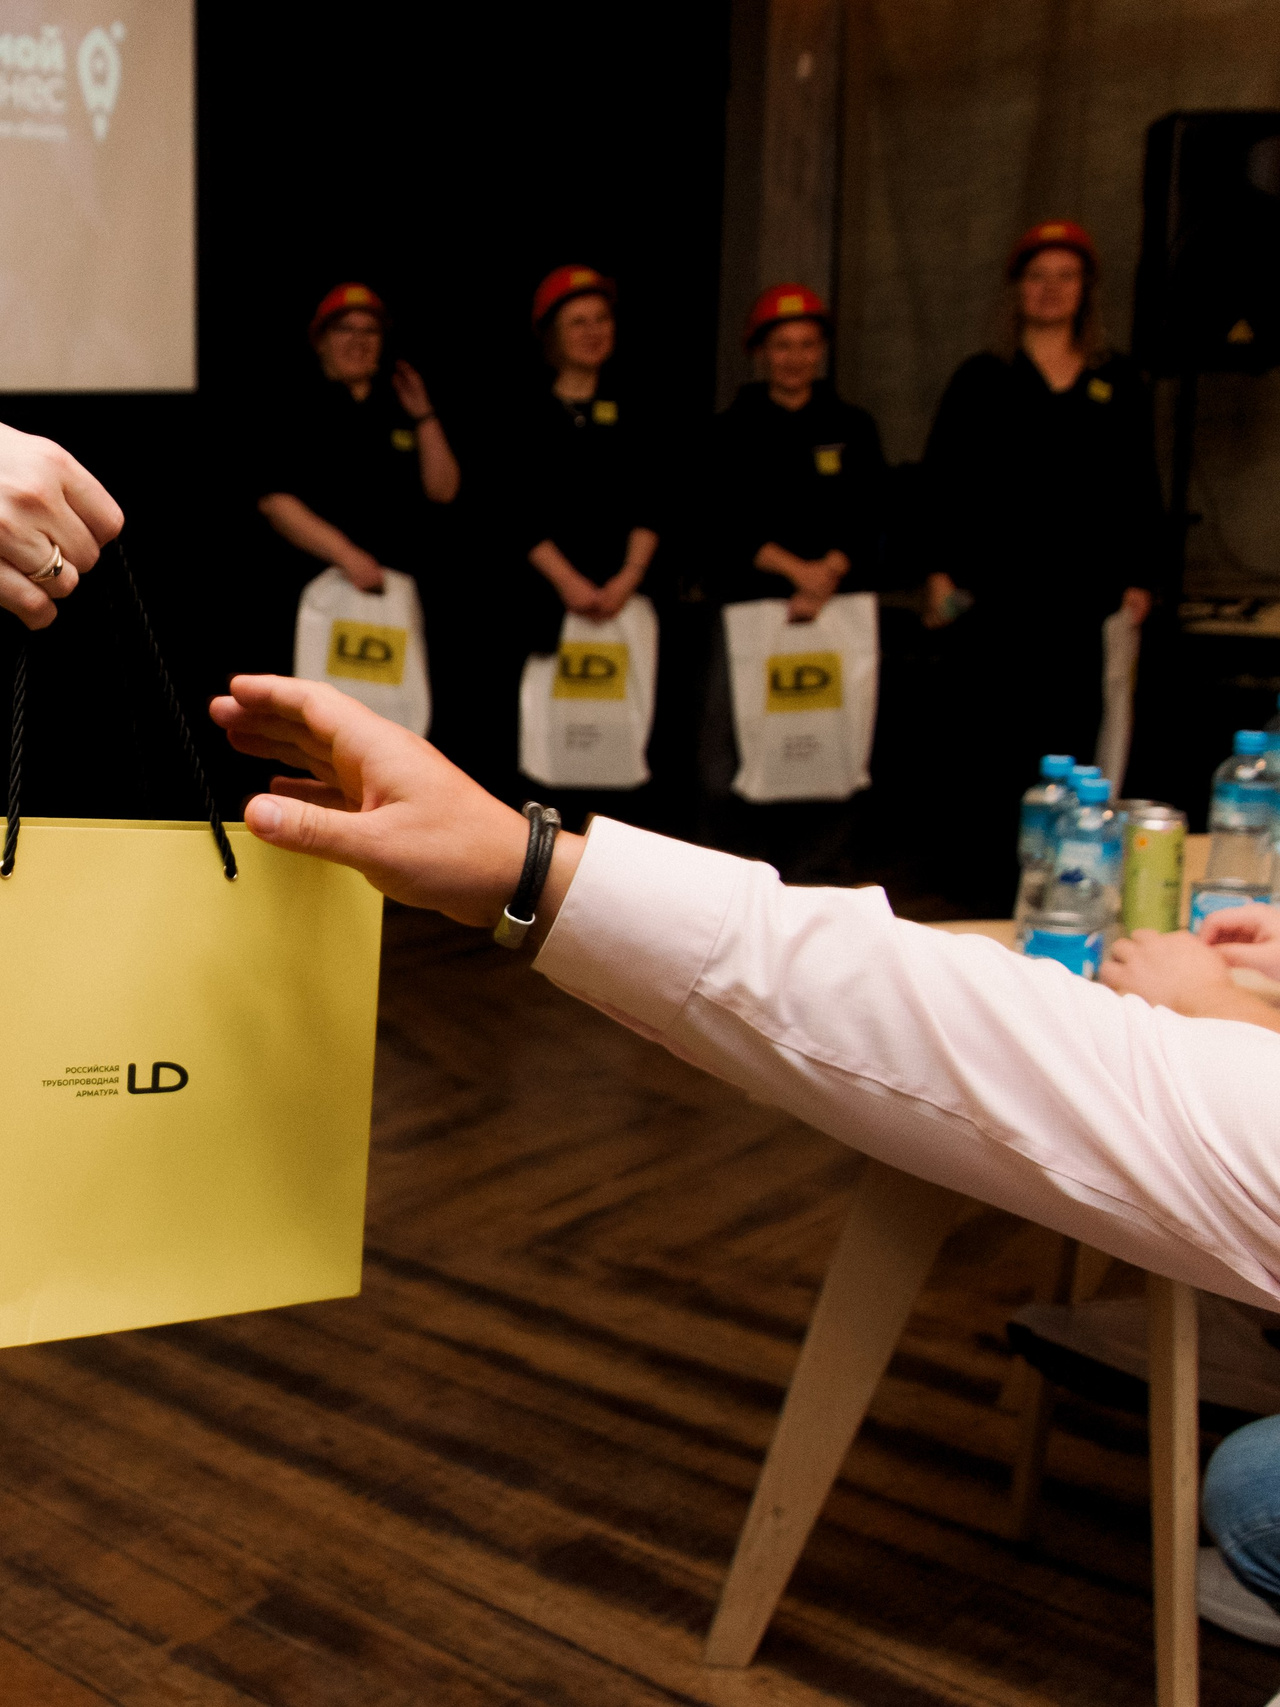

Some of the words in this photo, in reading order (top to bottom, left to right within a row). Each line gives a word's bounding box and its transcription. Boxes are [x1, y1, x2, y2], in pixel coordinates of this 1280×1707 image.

[65, 1064, 120, 1074] РОССИЙСКАЯ
[41, 1076, 120, 1087] ТРУБОПРОВОДНАЯ
[127, 1061, 189, 1095] LD
[76, 1088, 119, 1098] АРМАТУРА
